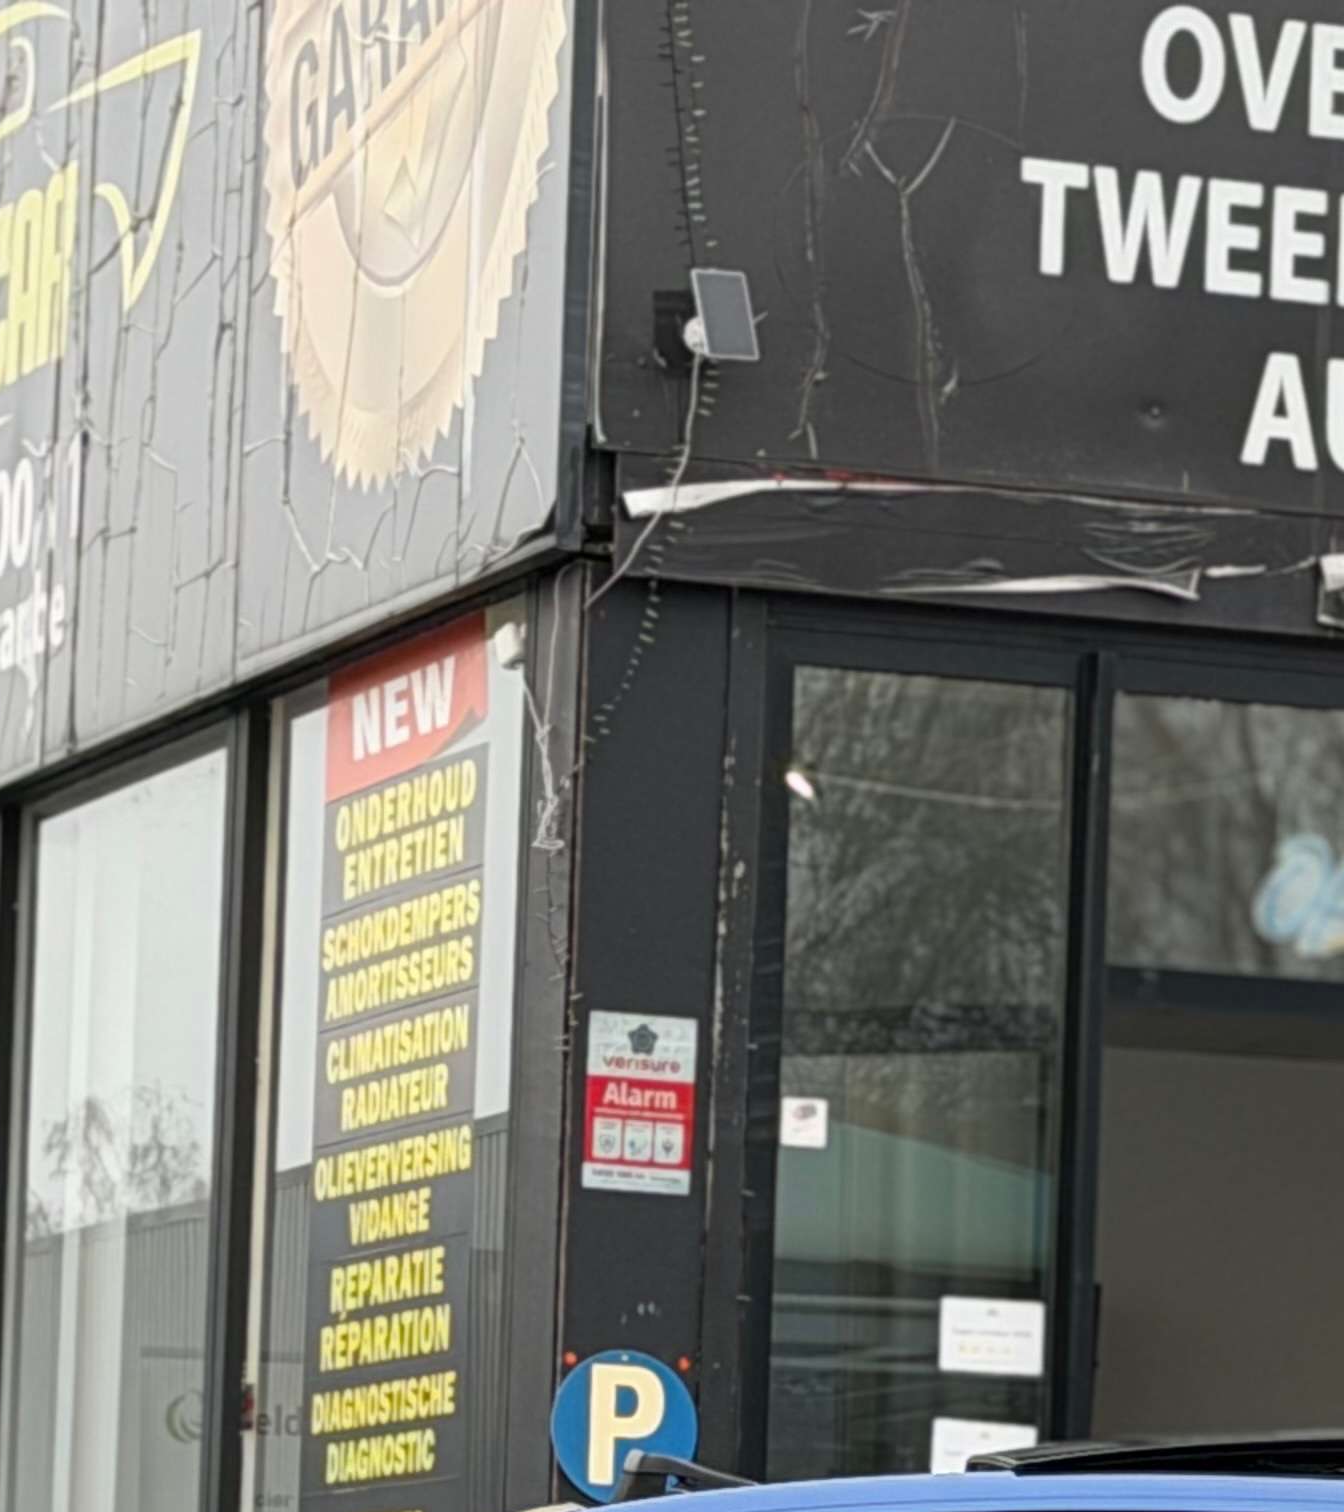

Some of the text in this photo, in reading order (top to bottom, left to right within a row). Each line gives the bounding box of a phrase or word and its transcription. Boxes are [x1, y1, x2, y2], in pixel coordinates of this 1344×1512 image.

[352, 655, 456, 763] NEW
[335, 758, 477, 850] ONDERHOUD
[342, 815, 465, 901] ENTRETIEN
[322, 879, 481, 971] SCHOKDEMPERS
[324, 937, 474, 1023] AMORTISSEURS
[325, 1003, 470, 1084] CLIMATISATION
[602, 1055, 681, 1074] verisure
[340, 1063, 449, 1133] RADIATEUR
[602, 1081, 678, 1110] Alarm
[313, 1124, 472, 1202] OLIEVERVERSING
[348, 1186, 432, 1246] VIDANGE
[329, 1245, 446, 1315] REPARATIE
[319, 1303, 452, 1373] RÉPARATION
[310, 1371, 457, 1435] DIAGNOSTISCHE
[587, 1363, 665, 1485] P
[324, 1427, 436, 1484] DIAGNOSTIC
